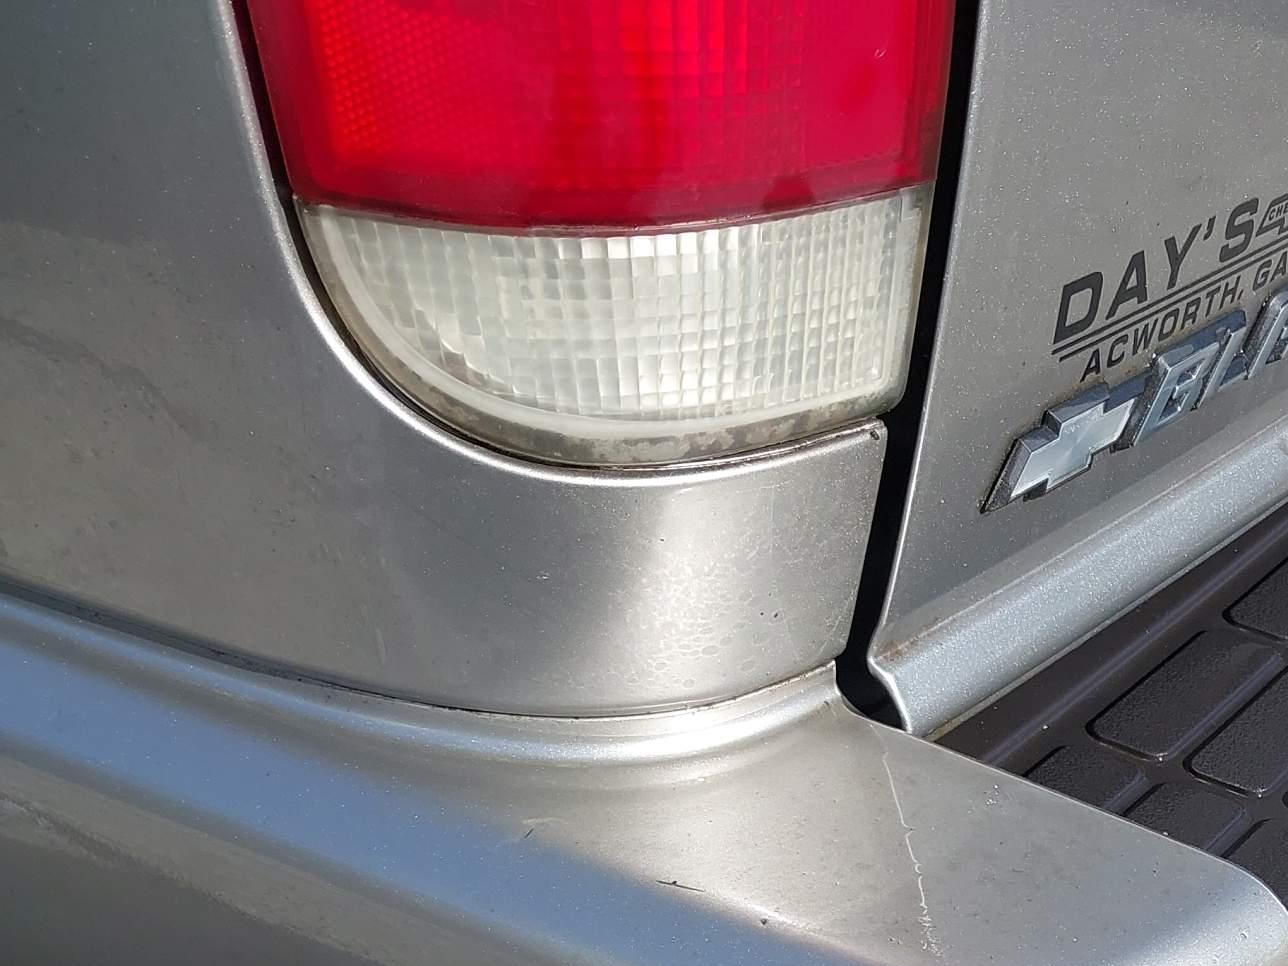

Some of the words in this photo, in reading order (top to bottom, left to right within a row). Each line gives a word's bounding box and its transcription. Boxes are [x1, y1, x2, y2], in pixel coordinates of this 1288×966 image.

[1052, 197, 1259, 345] DAY'S
[1079, 286, 1245, 383] ACWORTH,
[1252, 251, 1288, 292] GA
